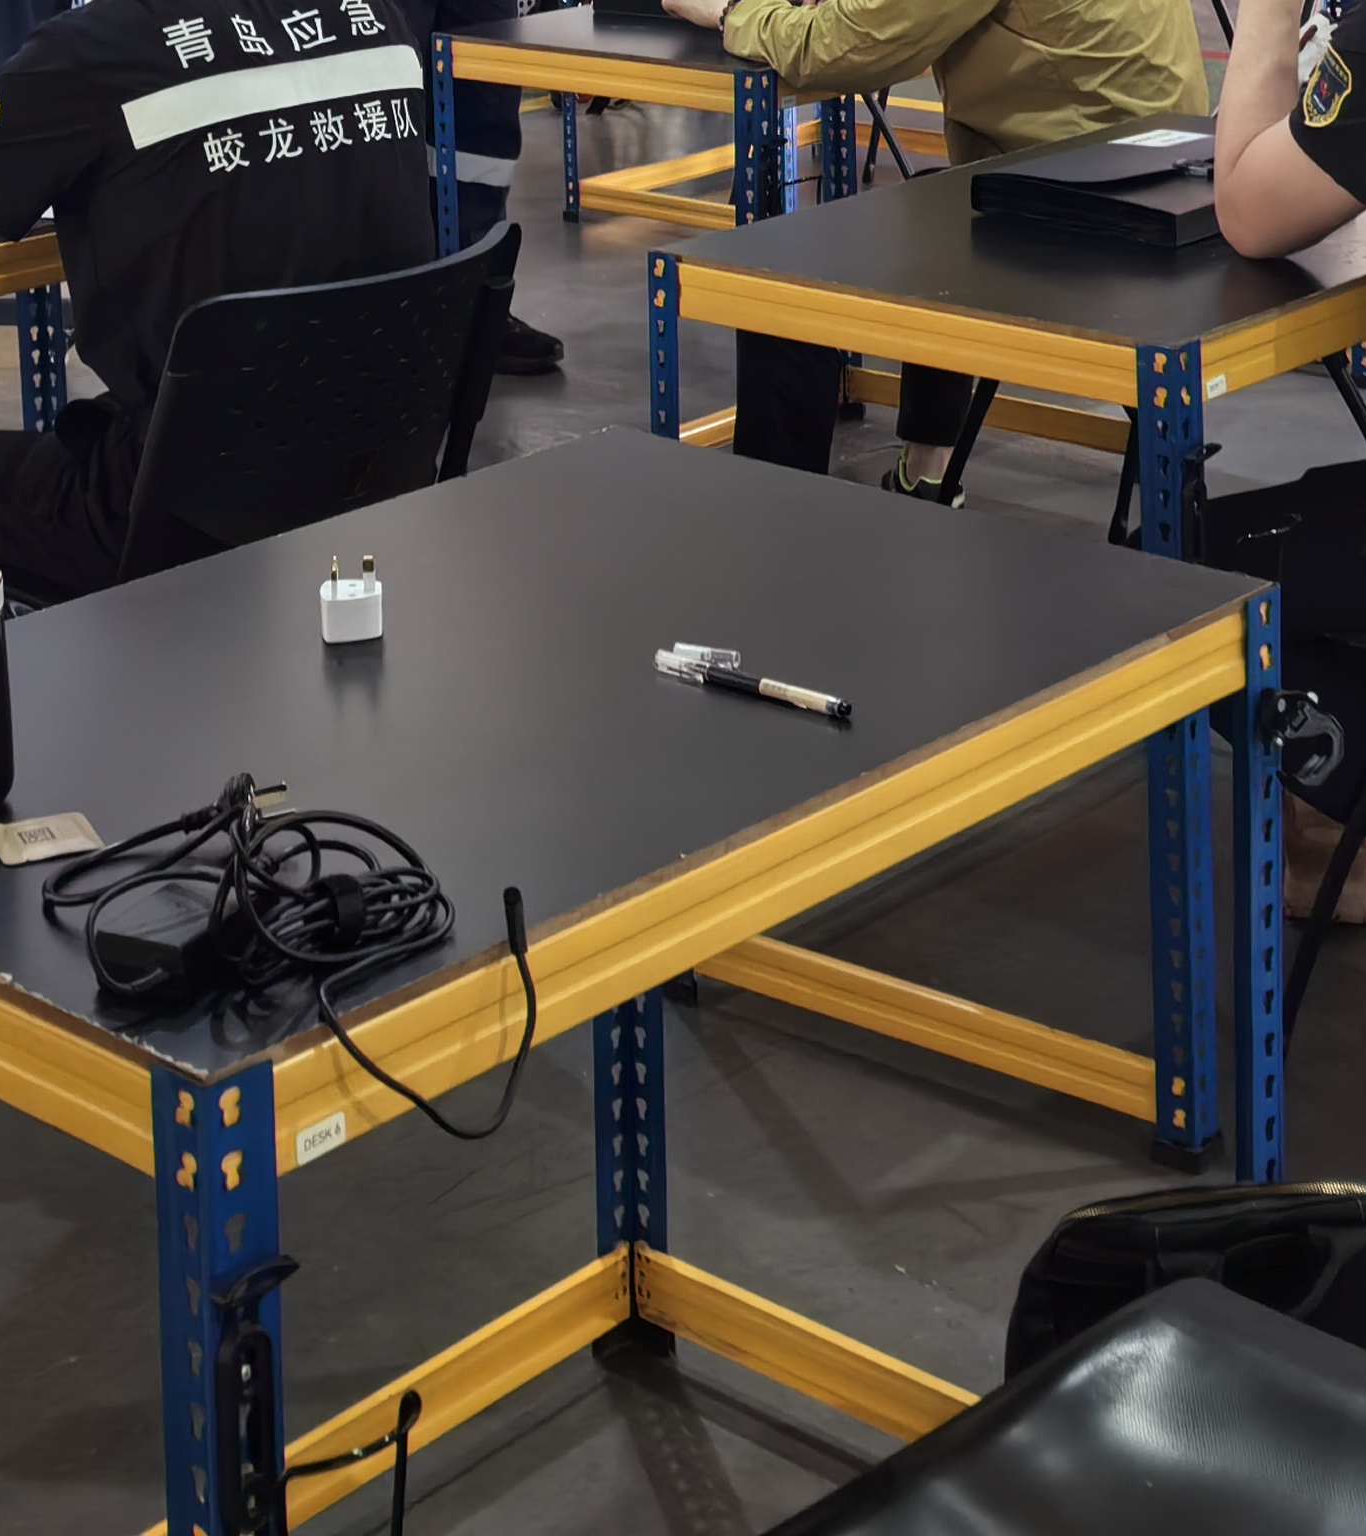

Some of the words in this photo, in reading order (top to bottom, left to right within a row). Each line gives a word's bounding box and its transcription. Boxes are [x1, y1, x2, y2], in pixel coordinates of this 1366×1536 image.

[203, 97, 420, 175] 蛟龙救援队
[303, 1128, 333, 1152] DESK
